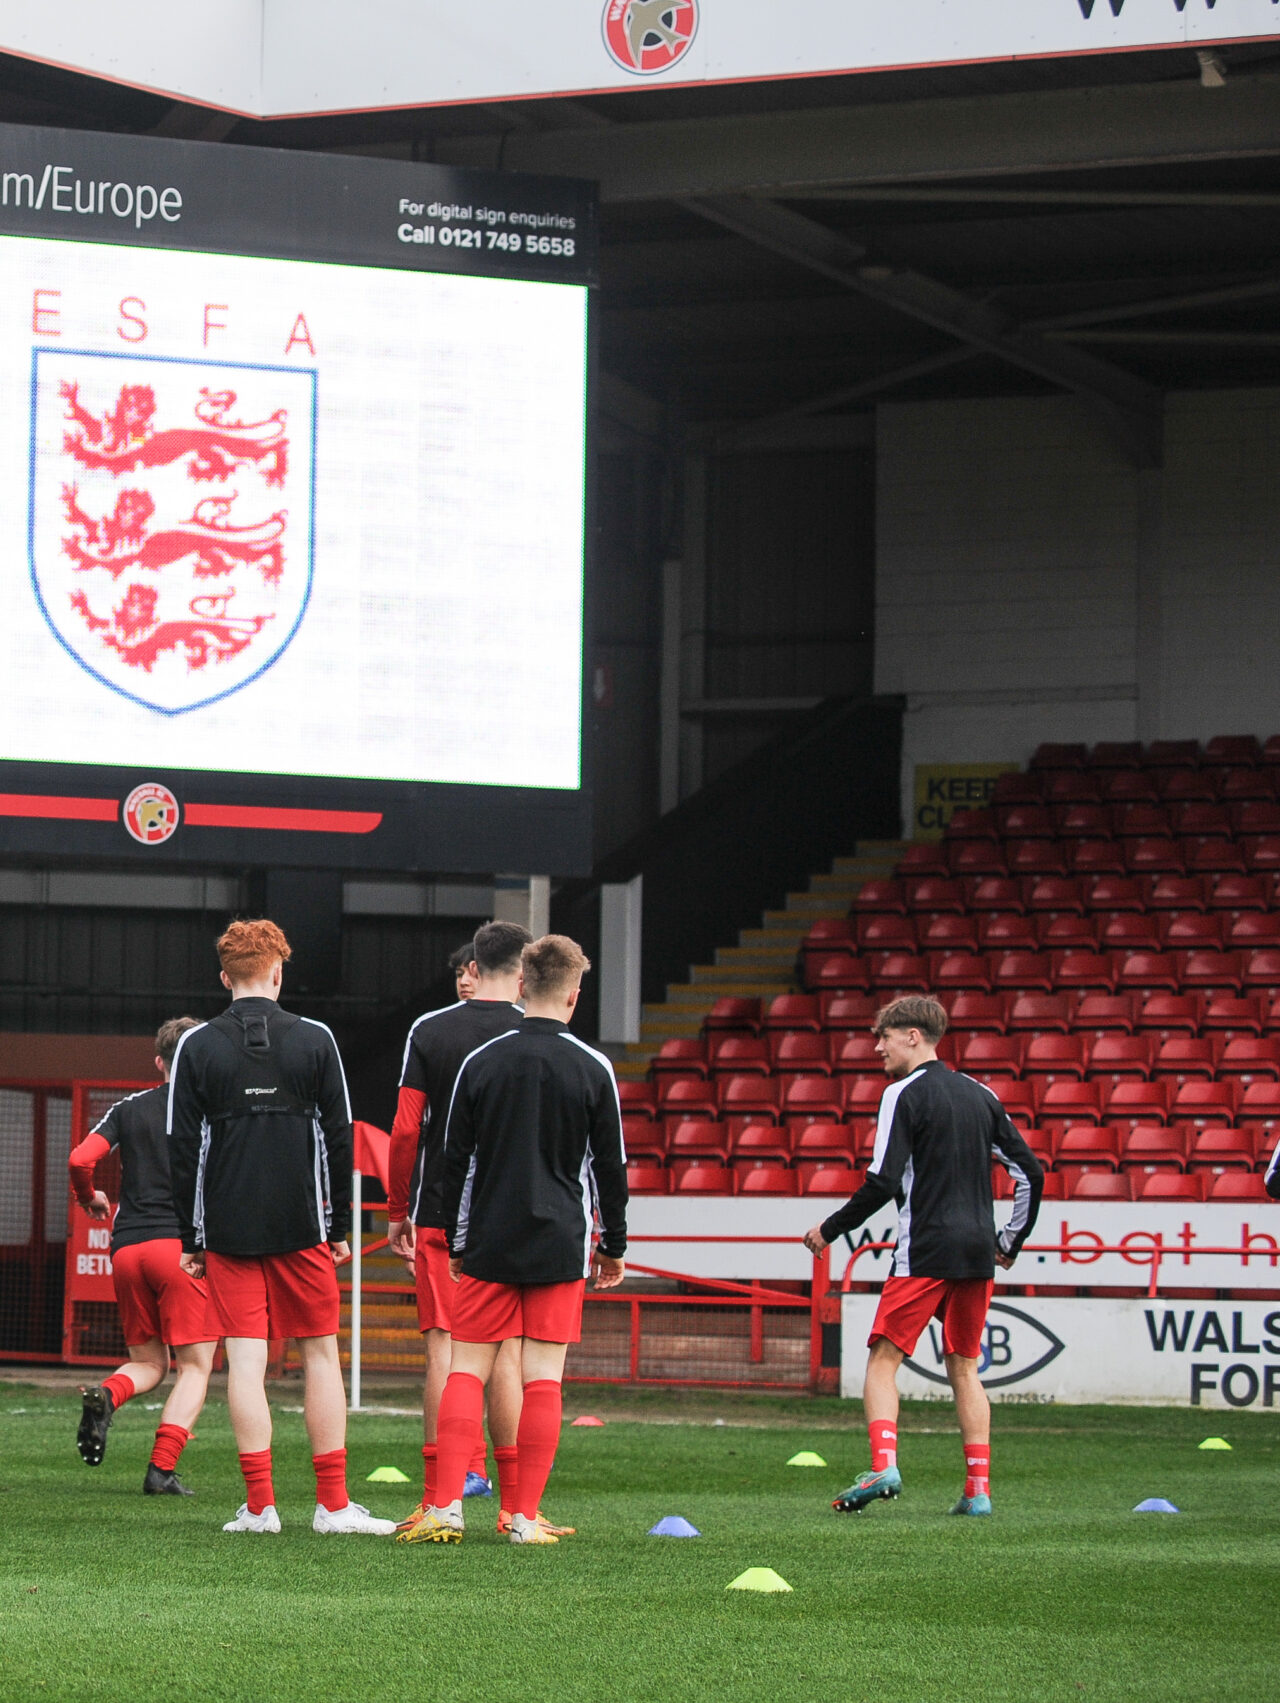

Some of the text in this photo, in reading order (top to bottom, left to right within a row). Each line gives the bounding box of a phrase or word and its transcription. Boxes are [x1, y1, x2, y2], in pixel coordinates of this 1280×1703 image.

[399, 199, 576, 230] For digital sign enquiries
[398, 223, 576, 256] Call 0121 749 5658
